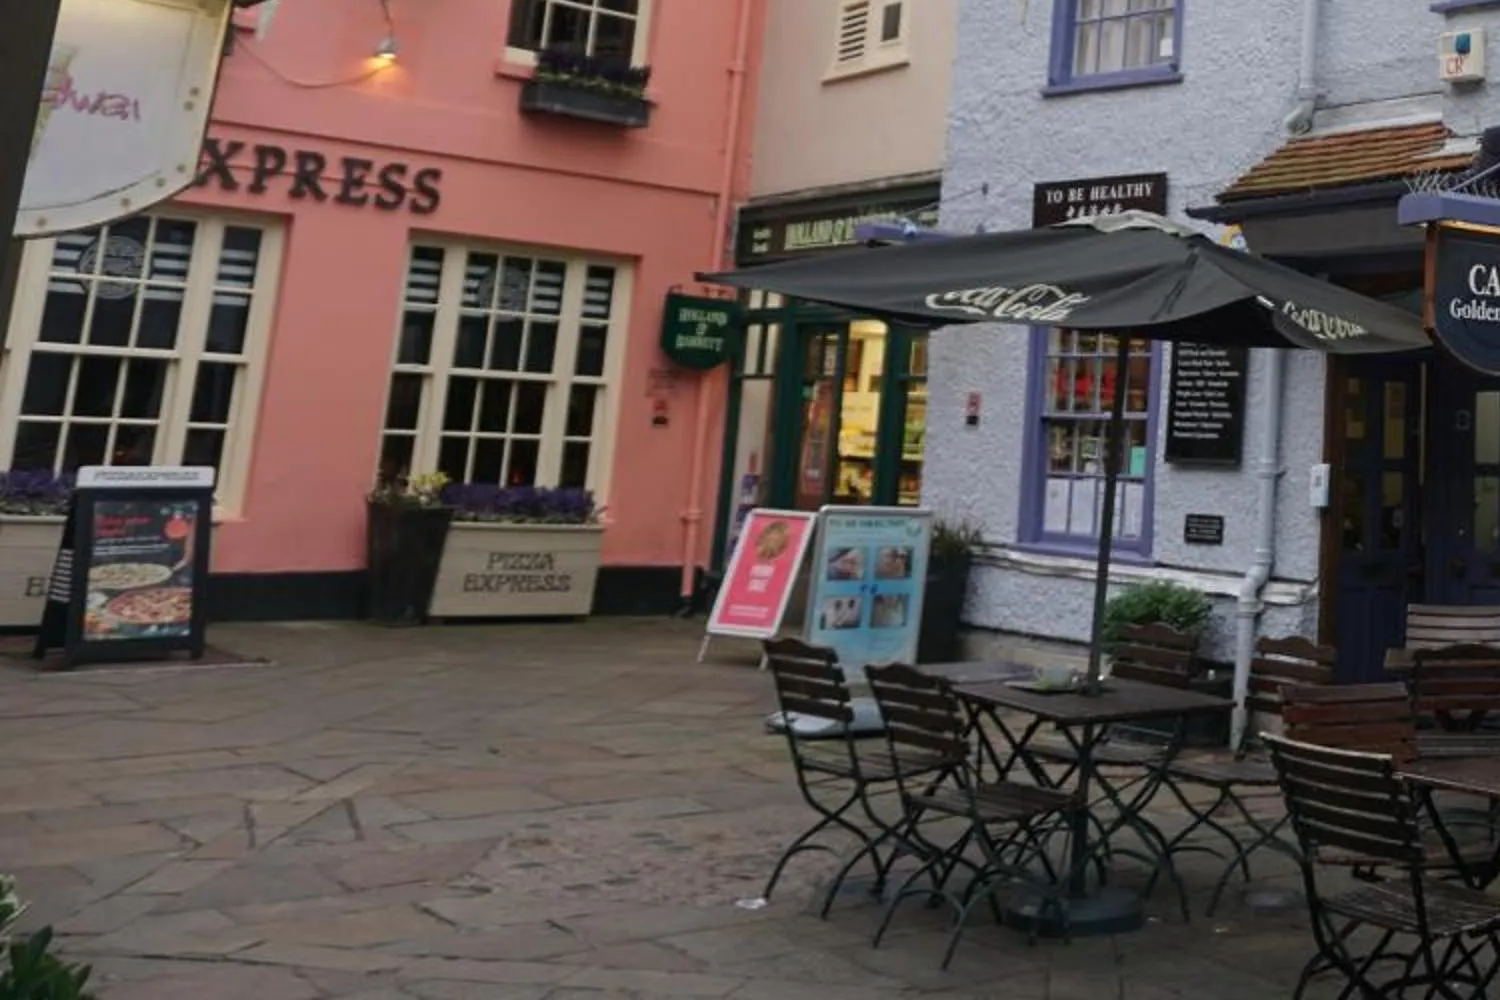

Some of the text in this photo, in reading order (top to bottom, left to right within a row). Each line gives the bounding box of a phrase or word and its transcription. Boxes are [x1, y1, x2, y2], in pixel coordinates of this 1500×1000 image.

[195, 137, 443, 216] XPRESS
[1045, 182, 1155, 204] TO BE HEALTHY
[486, 552, 555, 571] PIZZA
[463, 572, 572, 593] EXPRESS
